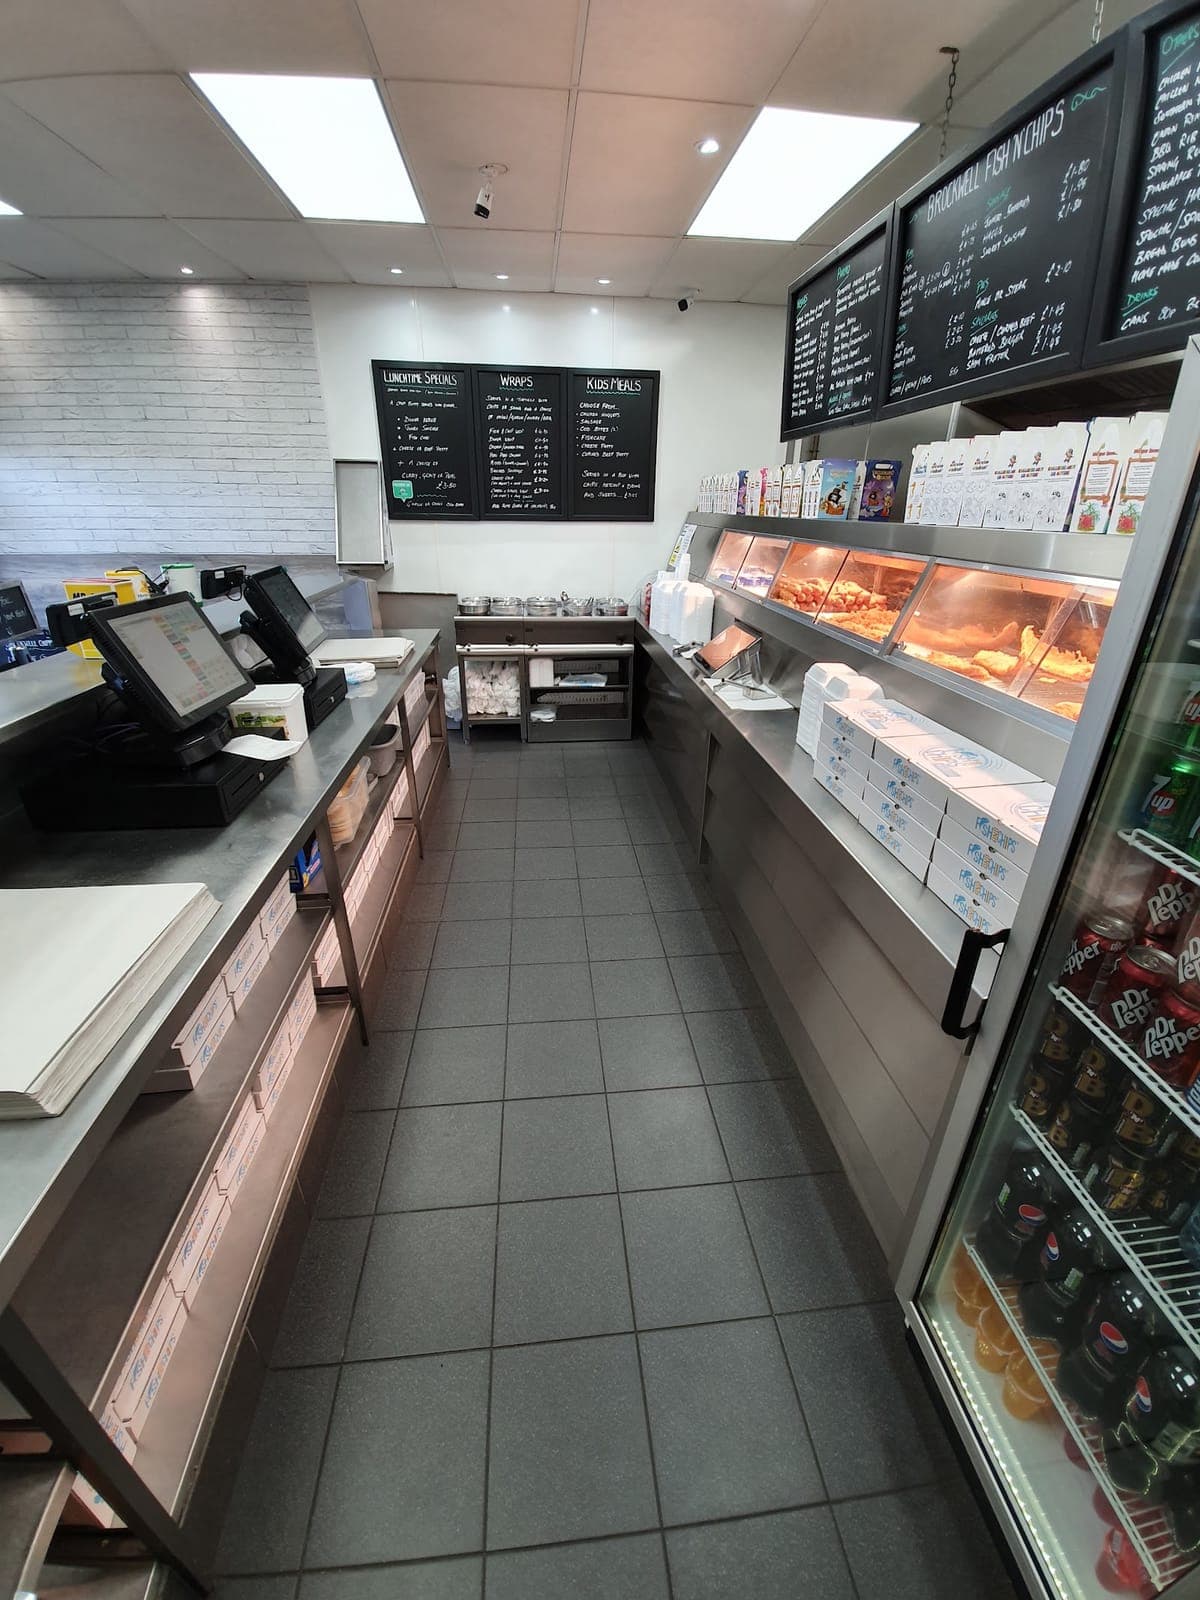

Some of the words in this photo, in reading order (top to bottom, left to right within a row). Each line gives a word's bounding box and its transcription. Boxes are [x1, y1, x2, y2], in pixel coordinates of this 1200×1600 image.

[1179, 130, 1198, 149] RIB
[927, 162, 980, 222] BROCKWELL
[985, 138, 1010, 182] FISH
[1127, 287, 1159, 305] DRINKS
[1121, 311, 1150, 331] CANS
[383, 370, 423, 384] LUNCHTIME
[424, 371, 457, 386] SPECIALS
[500, 373, 534, 387] WRAPS
[586, 377, 609, 390] KIDS
[610, 377, 642, 392] MEALS
[1142, 773, 1171, 813] 7
[1151, 795, 1174, 812] up
[1158, 882, 1183, 904] Dr
[1123, 988, 1150, 1010] Dr
[1155, 1016, 1176, 1038] Dr
[1145, 1024, 1200, 1059] Peppe
